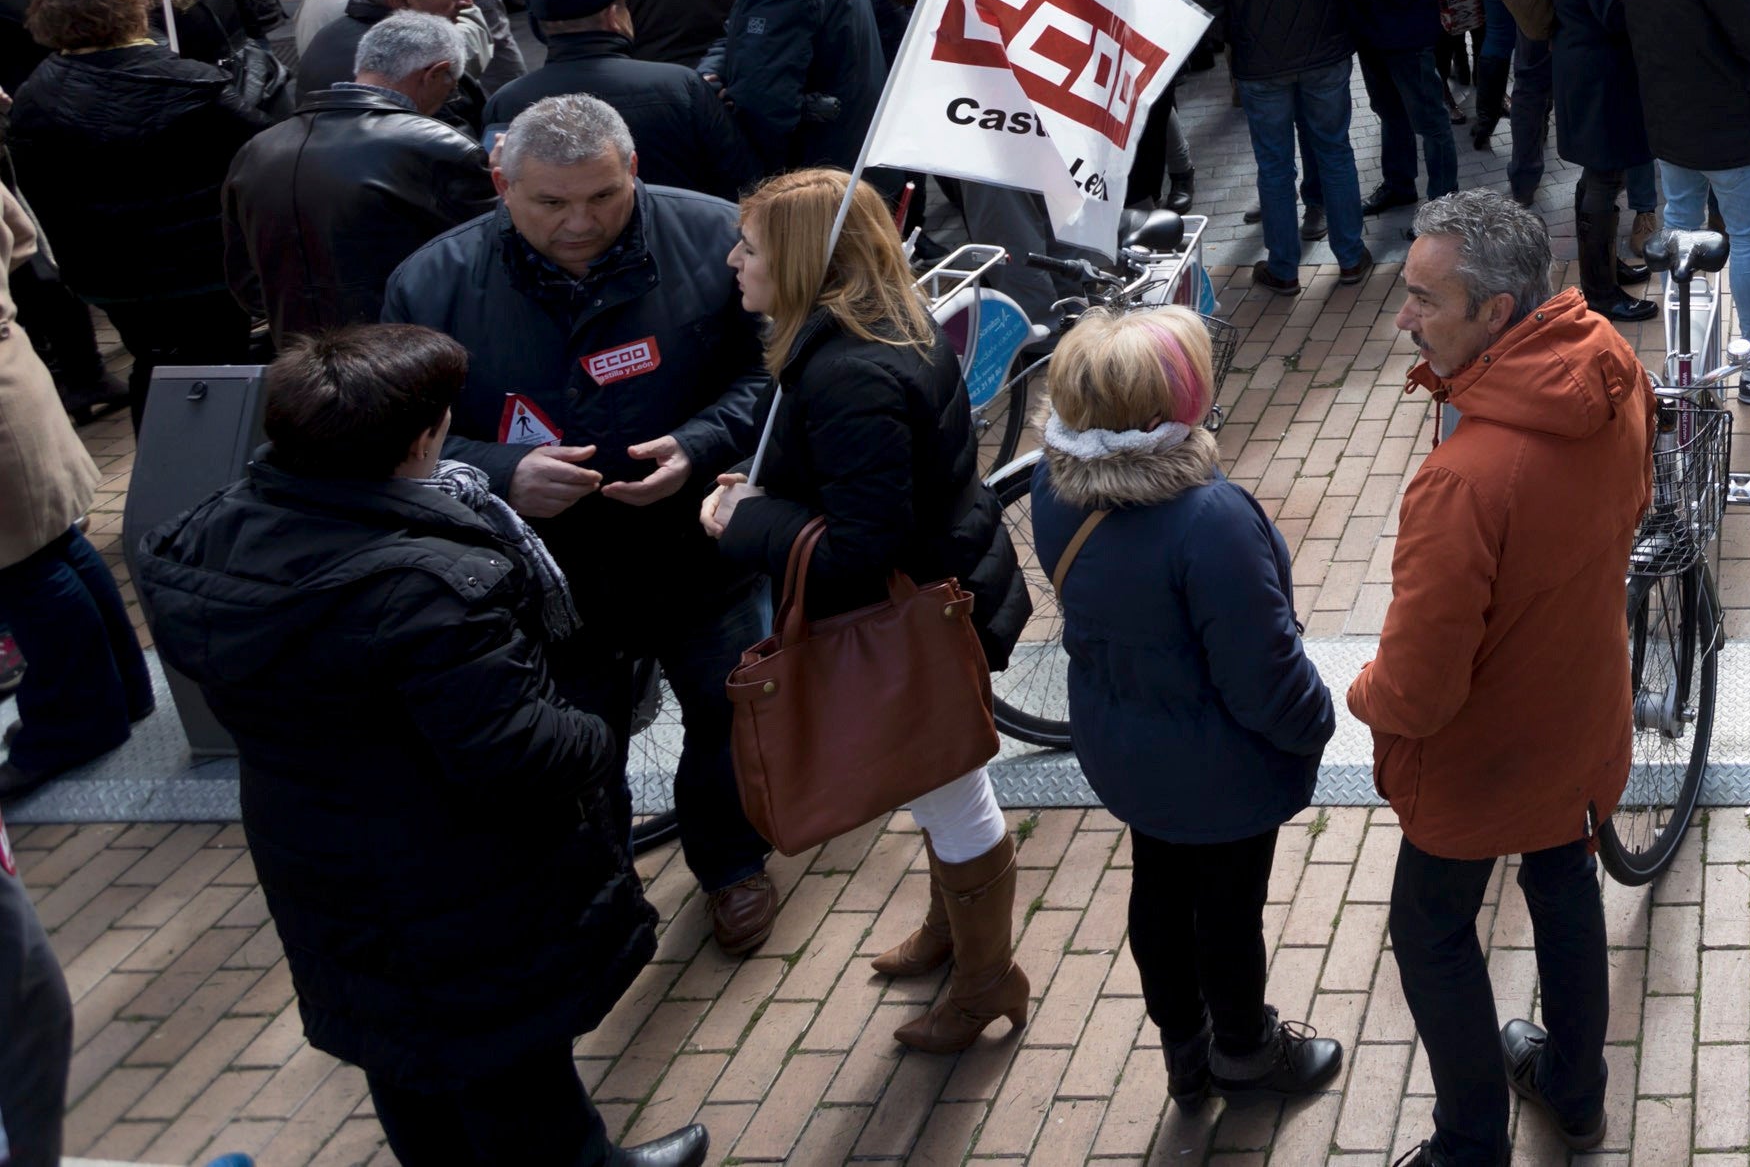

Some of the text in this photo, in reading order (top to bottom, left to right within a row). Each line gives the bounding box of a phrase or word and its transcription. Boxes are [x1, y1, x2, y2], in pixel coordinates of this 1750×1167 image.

[1069, 157, 1109, 203] León
[593, 347, 646, 371] CCOO
[600, 368, 624, 381] astilla
[632, 361, 654, 372] León
